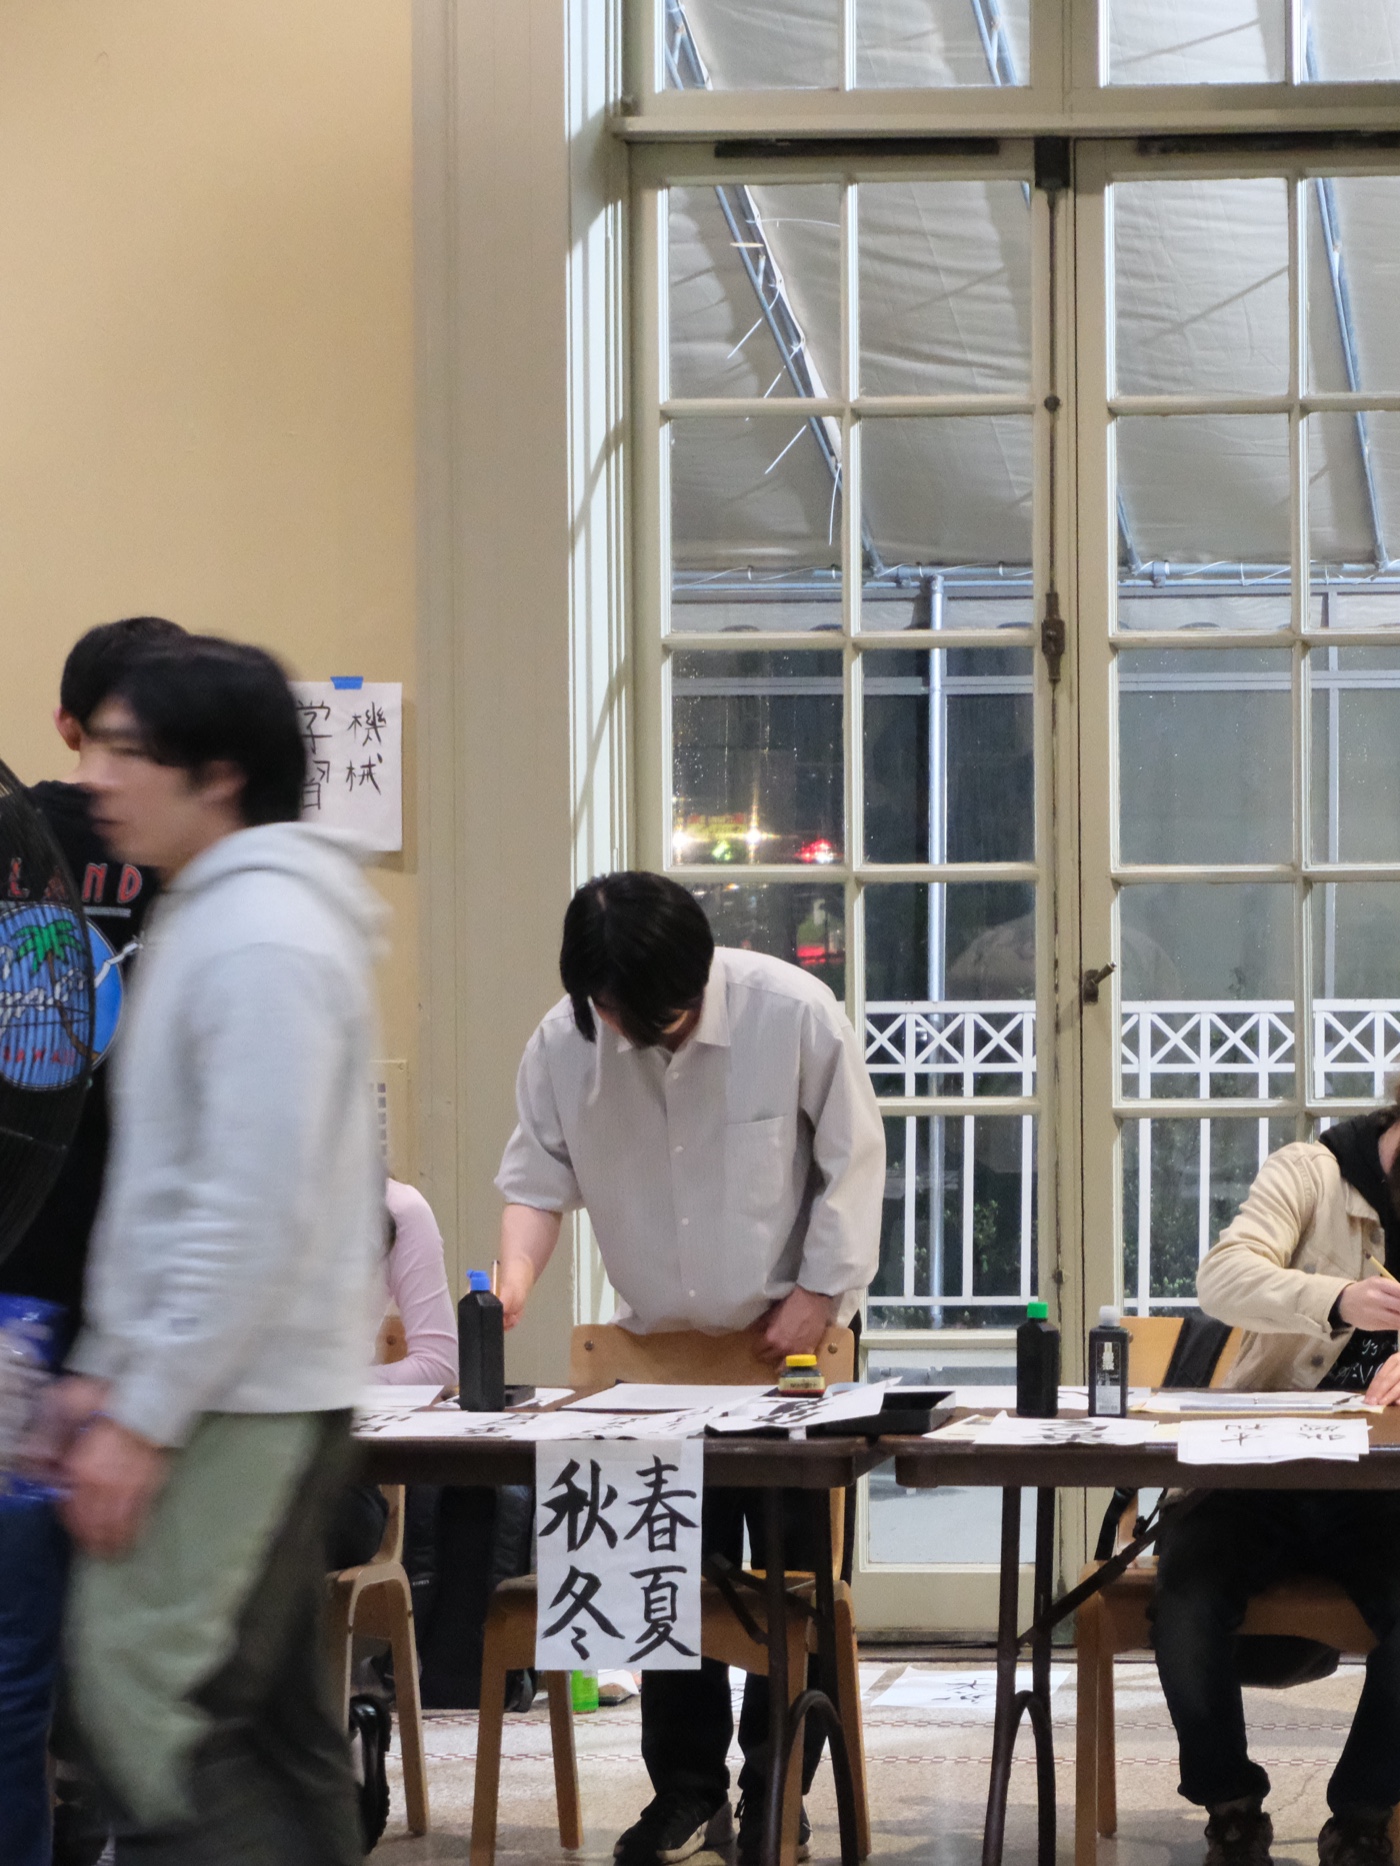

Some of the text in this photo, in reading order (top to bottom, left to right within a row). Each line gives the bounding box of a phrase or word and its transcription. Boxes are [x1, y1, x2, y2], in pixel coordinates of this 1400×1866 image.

[346, 701, 387, 796] 機械
[539, 1458, 627, 1661] 秋冬
[622, 1455, 701, 1664] 春夏
